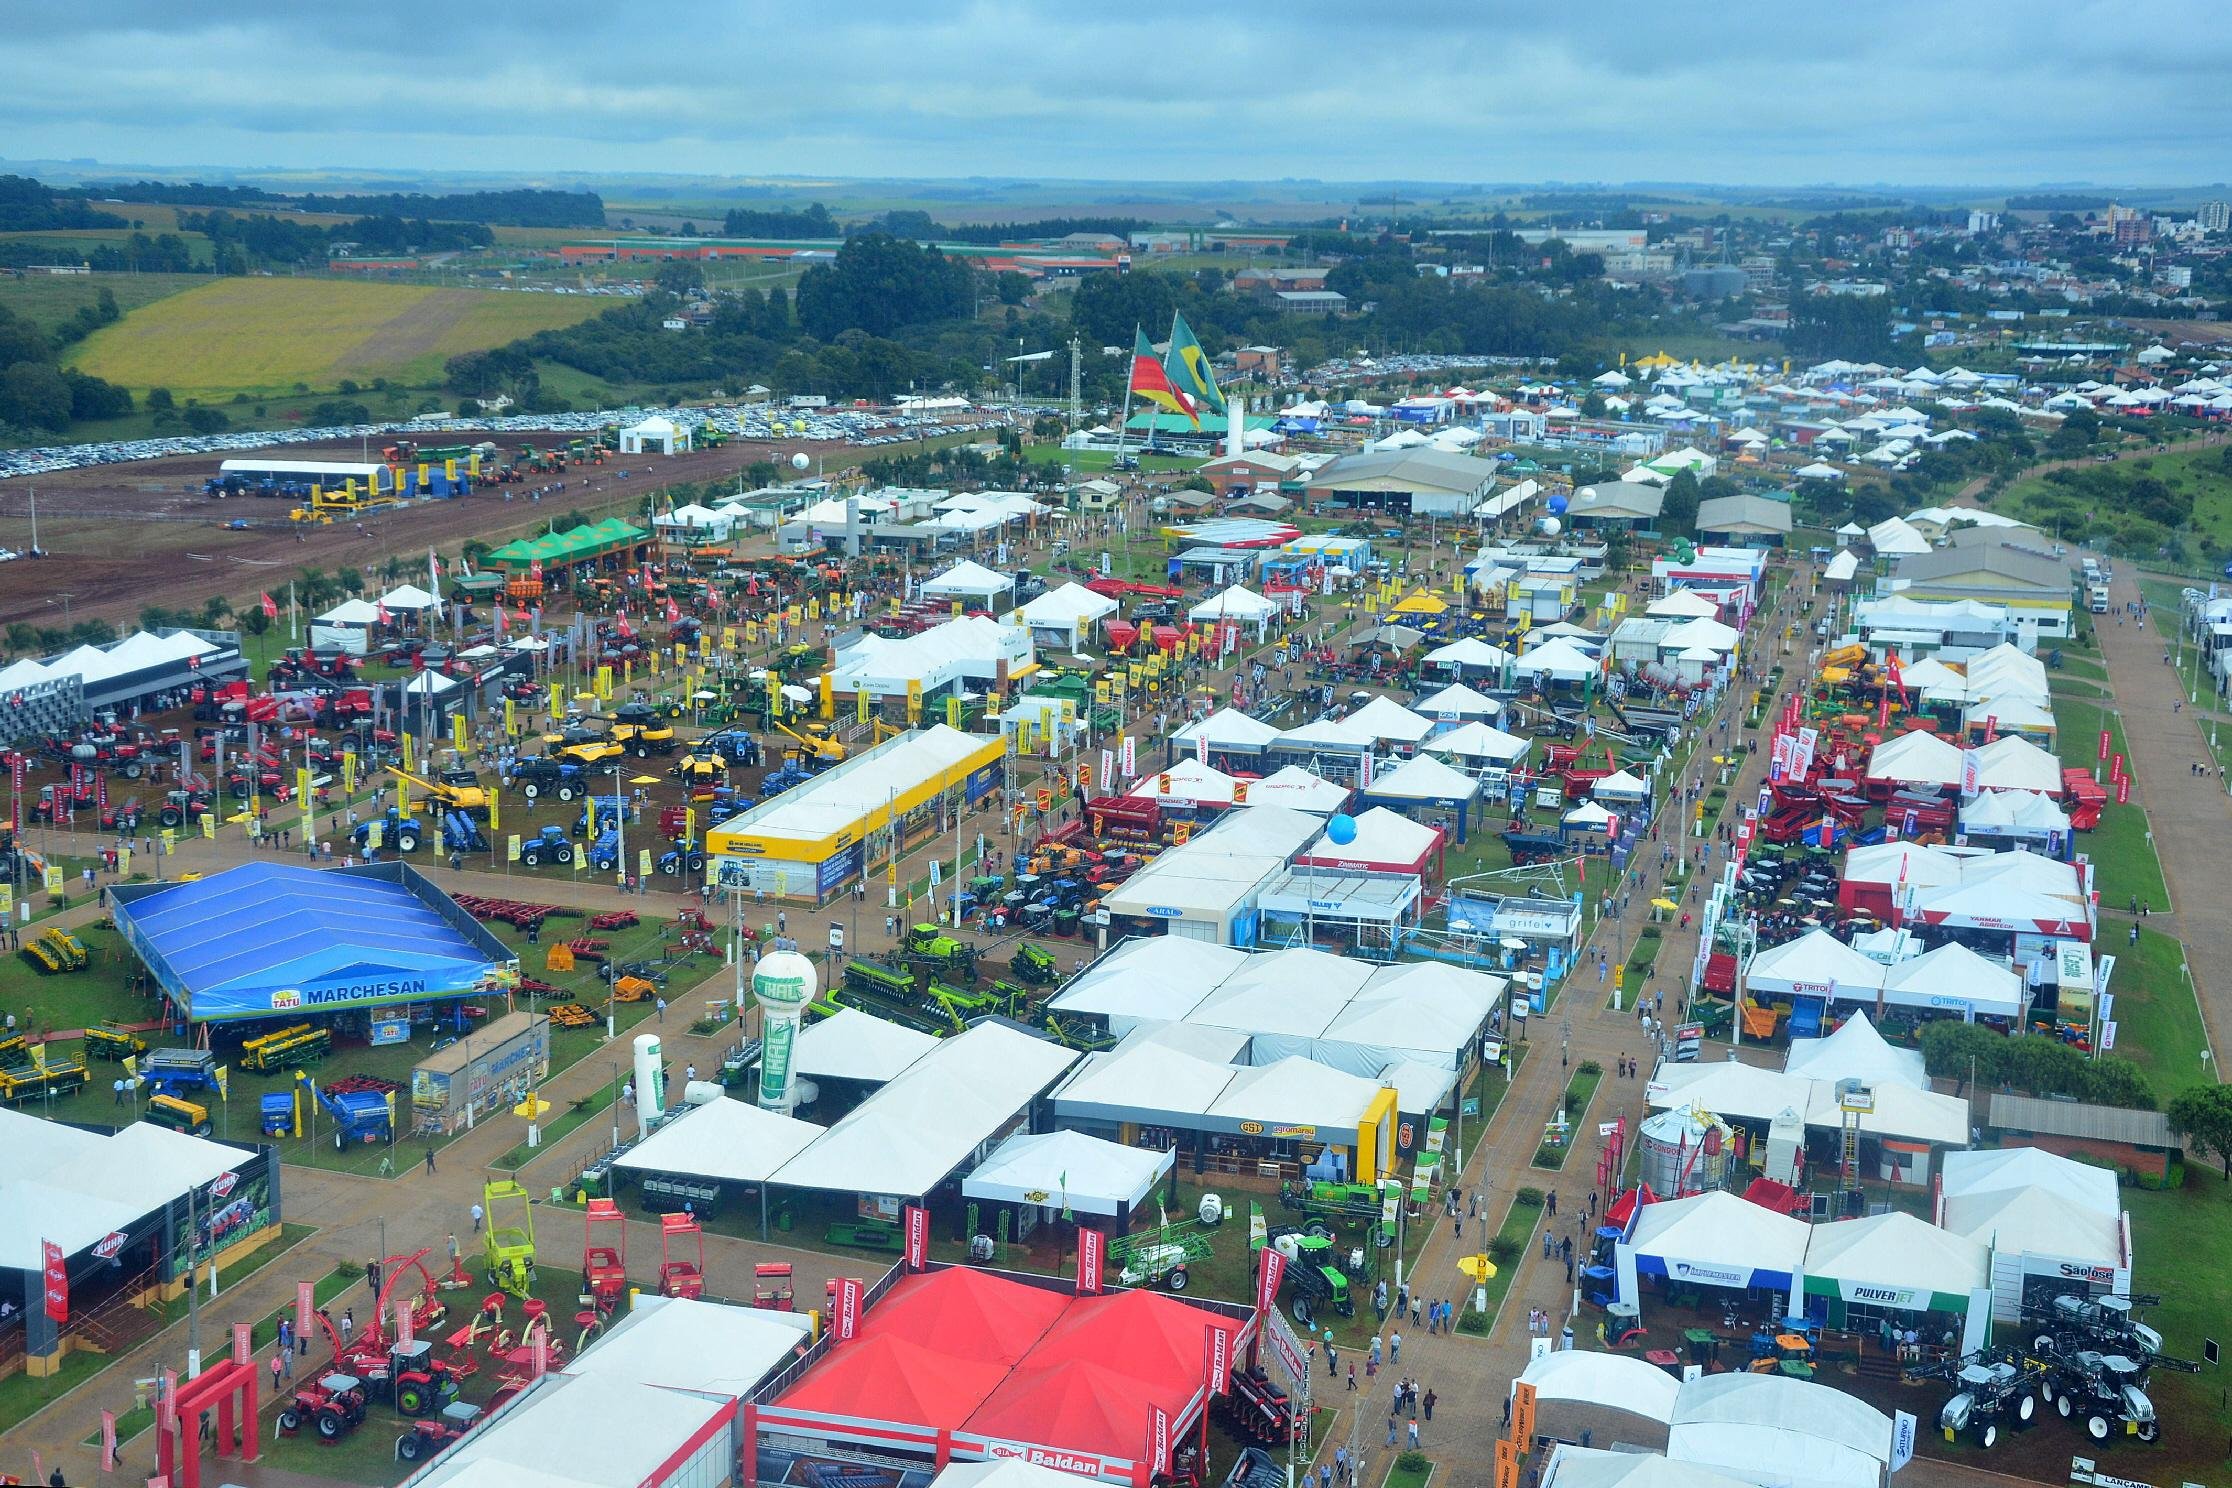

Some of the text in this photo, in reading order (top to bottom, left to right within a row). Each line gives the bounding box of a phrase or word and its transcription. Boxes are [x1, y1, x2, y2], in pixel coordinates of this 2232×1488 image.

[272, 998, 299, 1008] TATU
[306, 980, 424, 1004] MARCHESAN
[491, 1040, 540, 1076] MARCHESN
[1242, 1123, 1260, 1132] GSI
[1402, 1127, 1410, 1144] GSI
[211, 1173, 238, 1193] KUHN
[913, 1213, 921, 1246] Baldan
[97, 1234, 125, 1255] KUHN
[1087, 1234, 1096, 1269] Baldan
[1267, 1256, 1278, 1293] Baldan
[845, 1285, 854, 1319] Baldan
[1215, 1331, 1225, 1368] Baldan
[1897, 1419, 1908, 1457] SATURNO
[1030, 1451, 1097, 1473] Baldan
